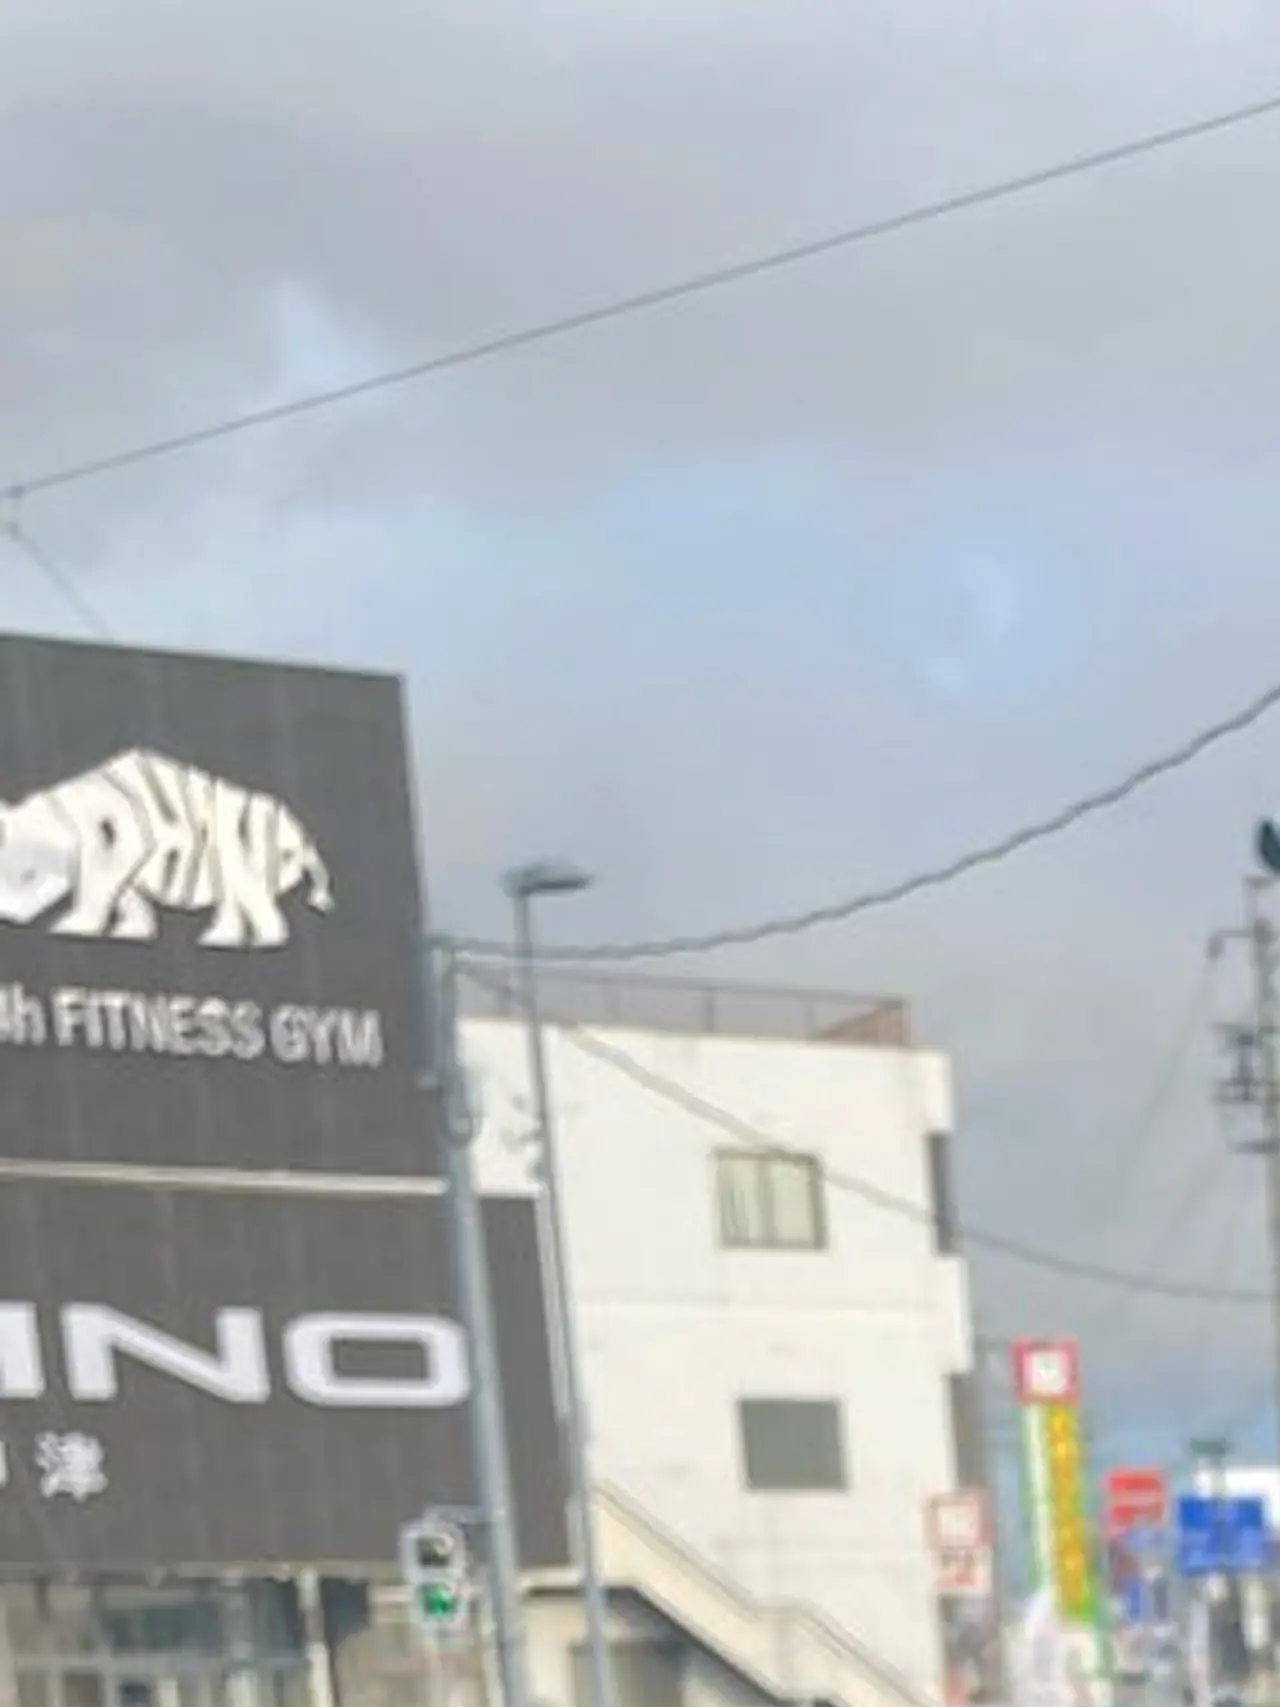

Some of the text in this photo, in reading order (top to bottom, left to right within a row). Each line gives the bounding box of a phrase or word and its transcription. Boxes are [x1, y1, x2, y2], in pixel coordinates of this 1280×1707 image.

[52, 986, 266, 1060] FITNESS
[268, 1003, 384, 1069] GYM
[0, 1300, 470, 1406] INO
